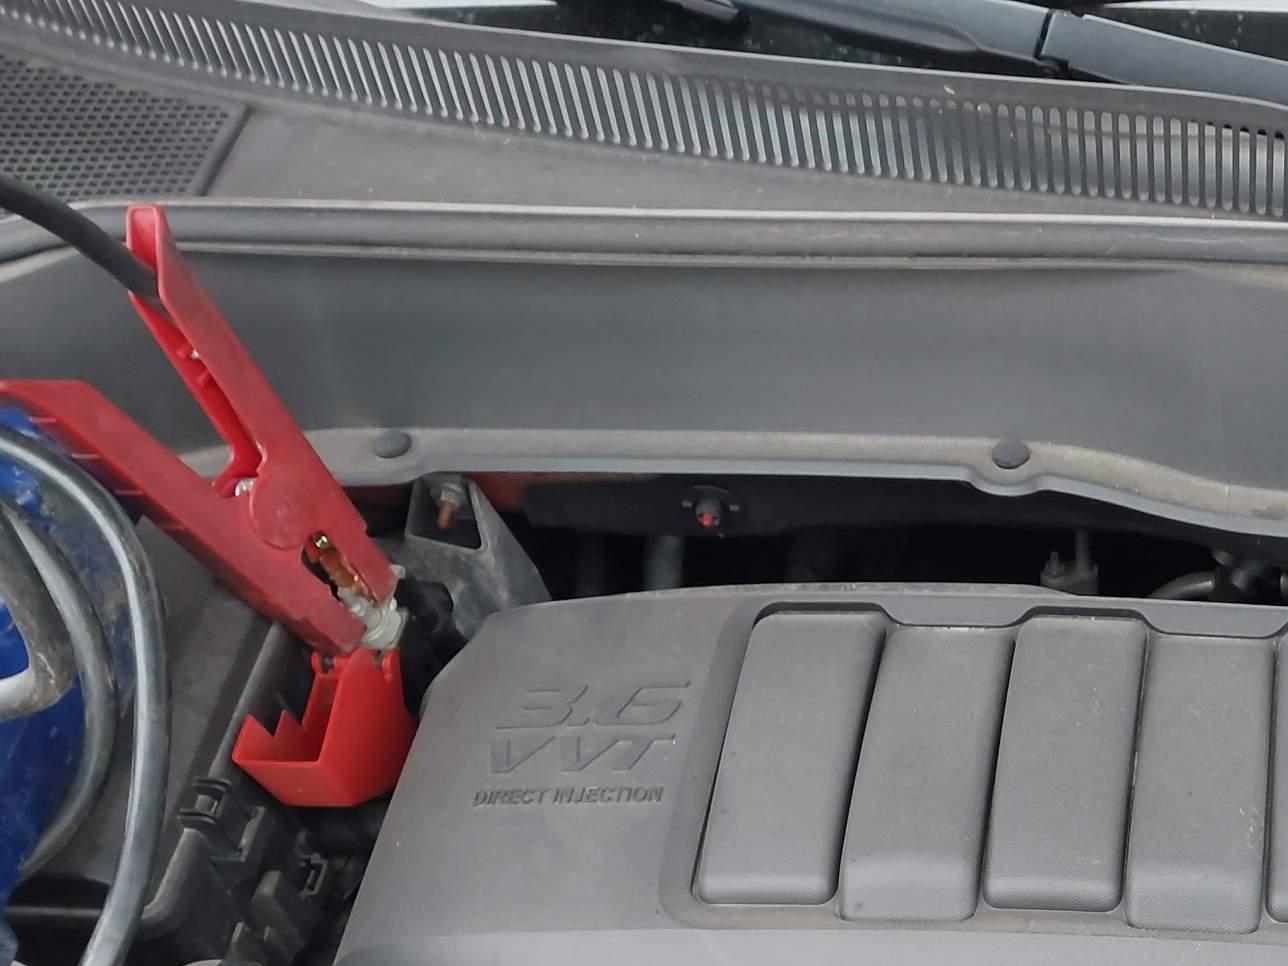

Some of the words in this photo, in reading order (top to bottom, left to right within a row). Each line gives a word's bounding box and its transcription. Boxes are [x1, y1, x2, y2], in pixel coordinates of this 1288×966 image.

[496, 681, 691, 730] 3.6
[490, 732, 676, 775] VVT
[472, 787, 550, 808] DIRECT
[553, 785, 665, 804] INJECTION
